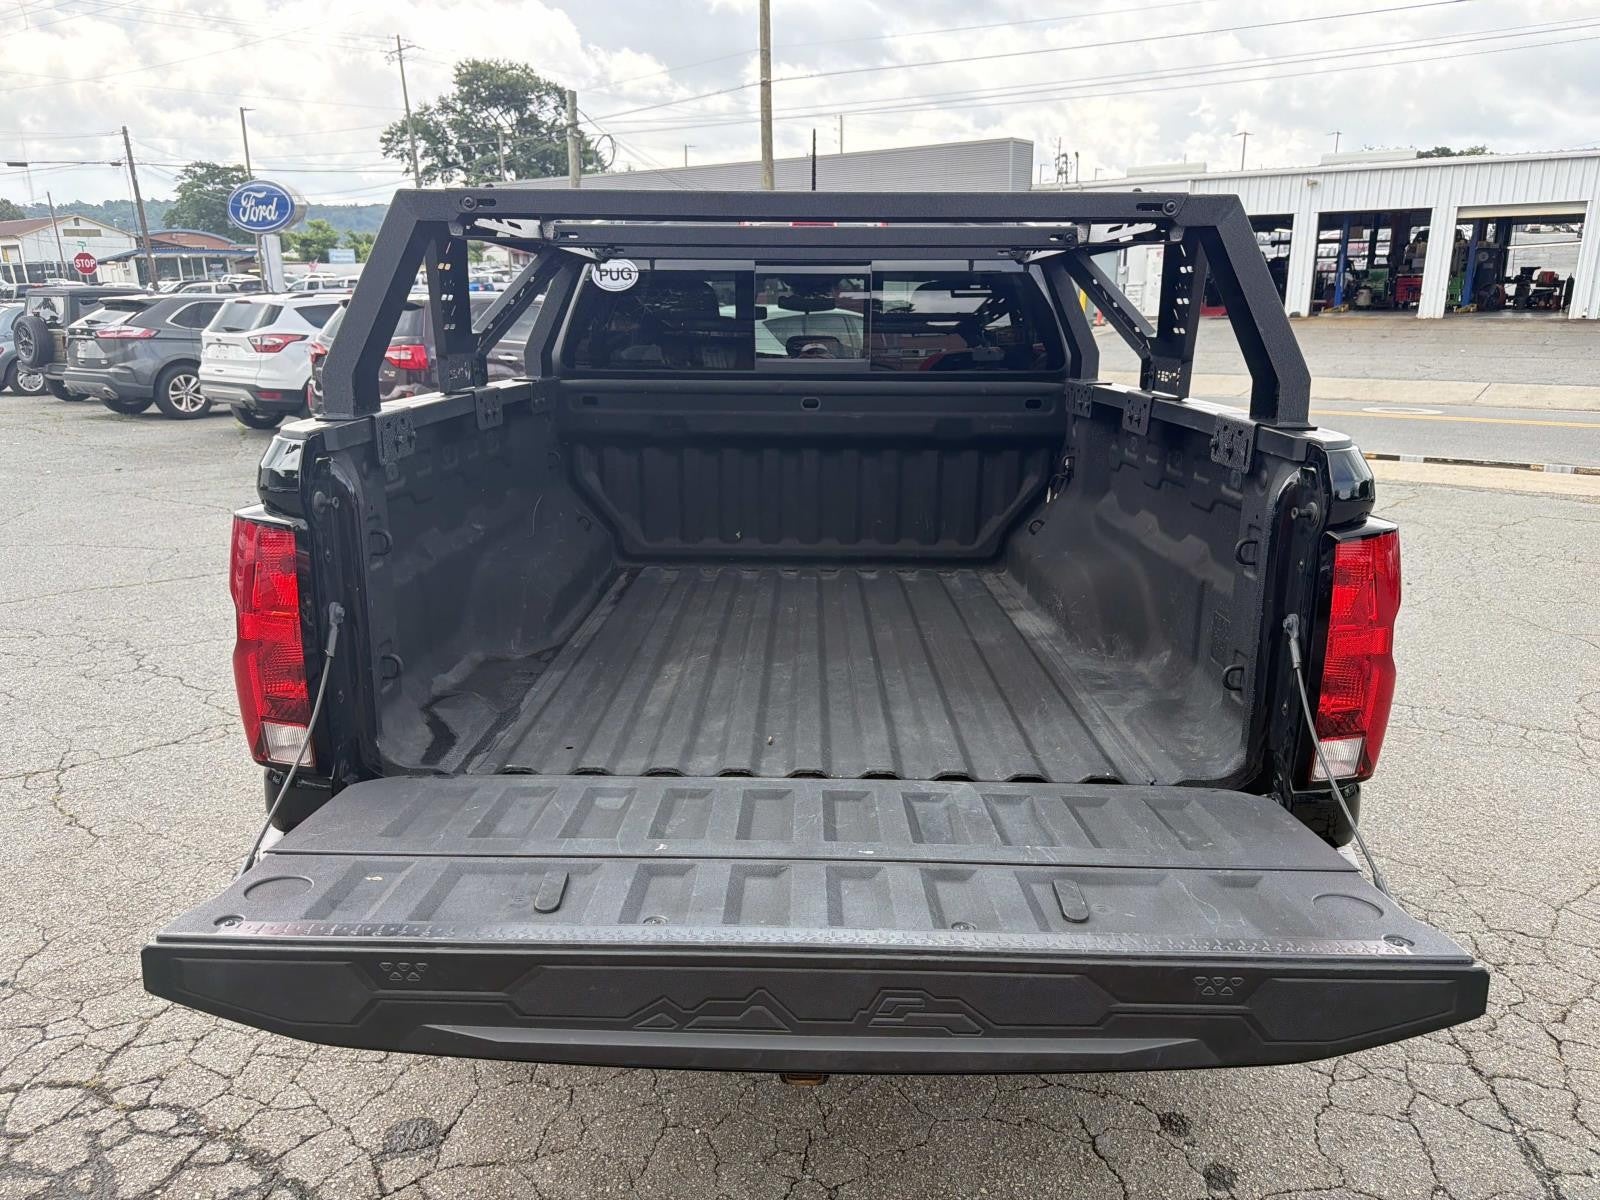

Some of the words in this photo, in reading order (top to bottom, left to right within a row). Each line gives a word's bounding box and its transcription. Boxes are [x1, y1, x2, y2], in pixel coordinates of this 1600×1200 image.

[240, 191, 278, 222] Ford
[75, 259, 95, 268] STOP
[600, 267, 632, 281] PUG
